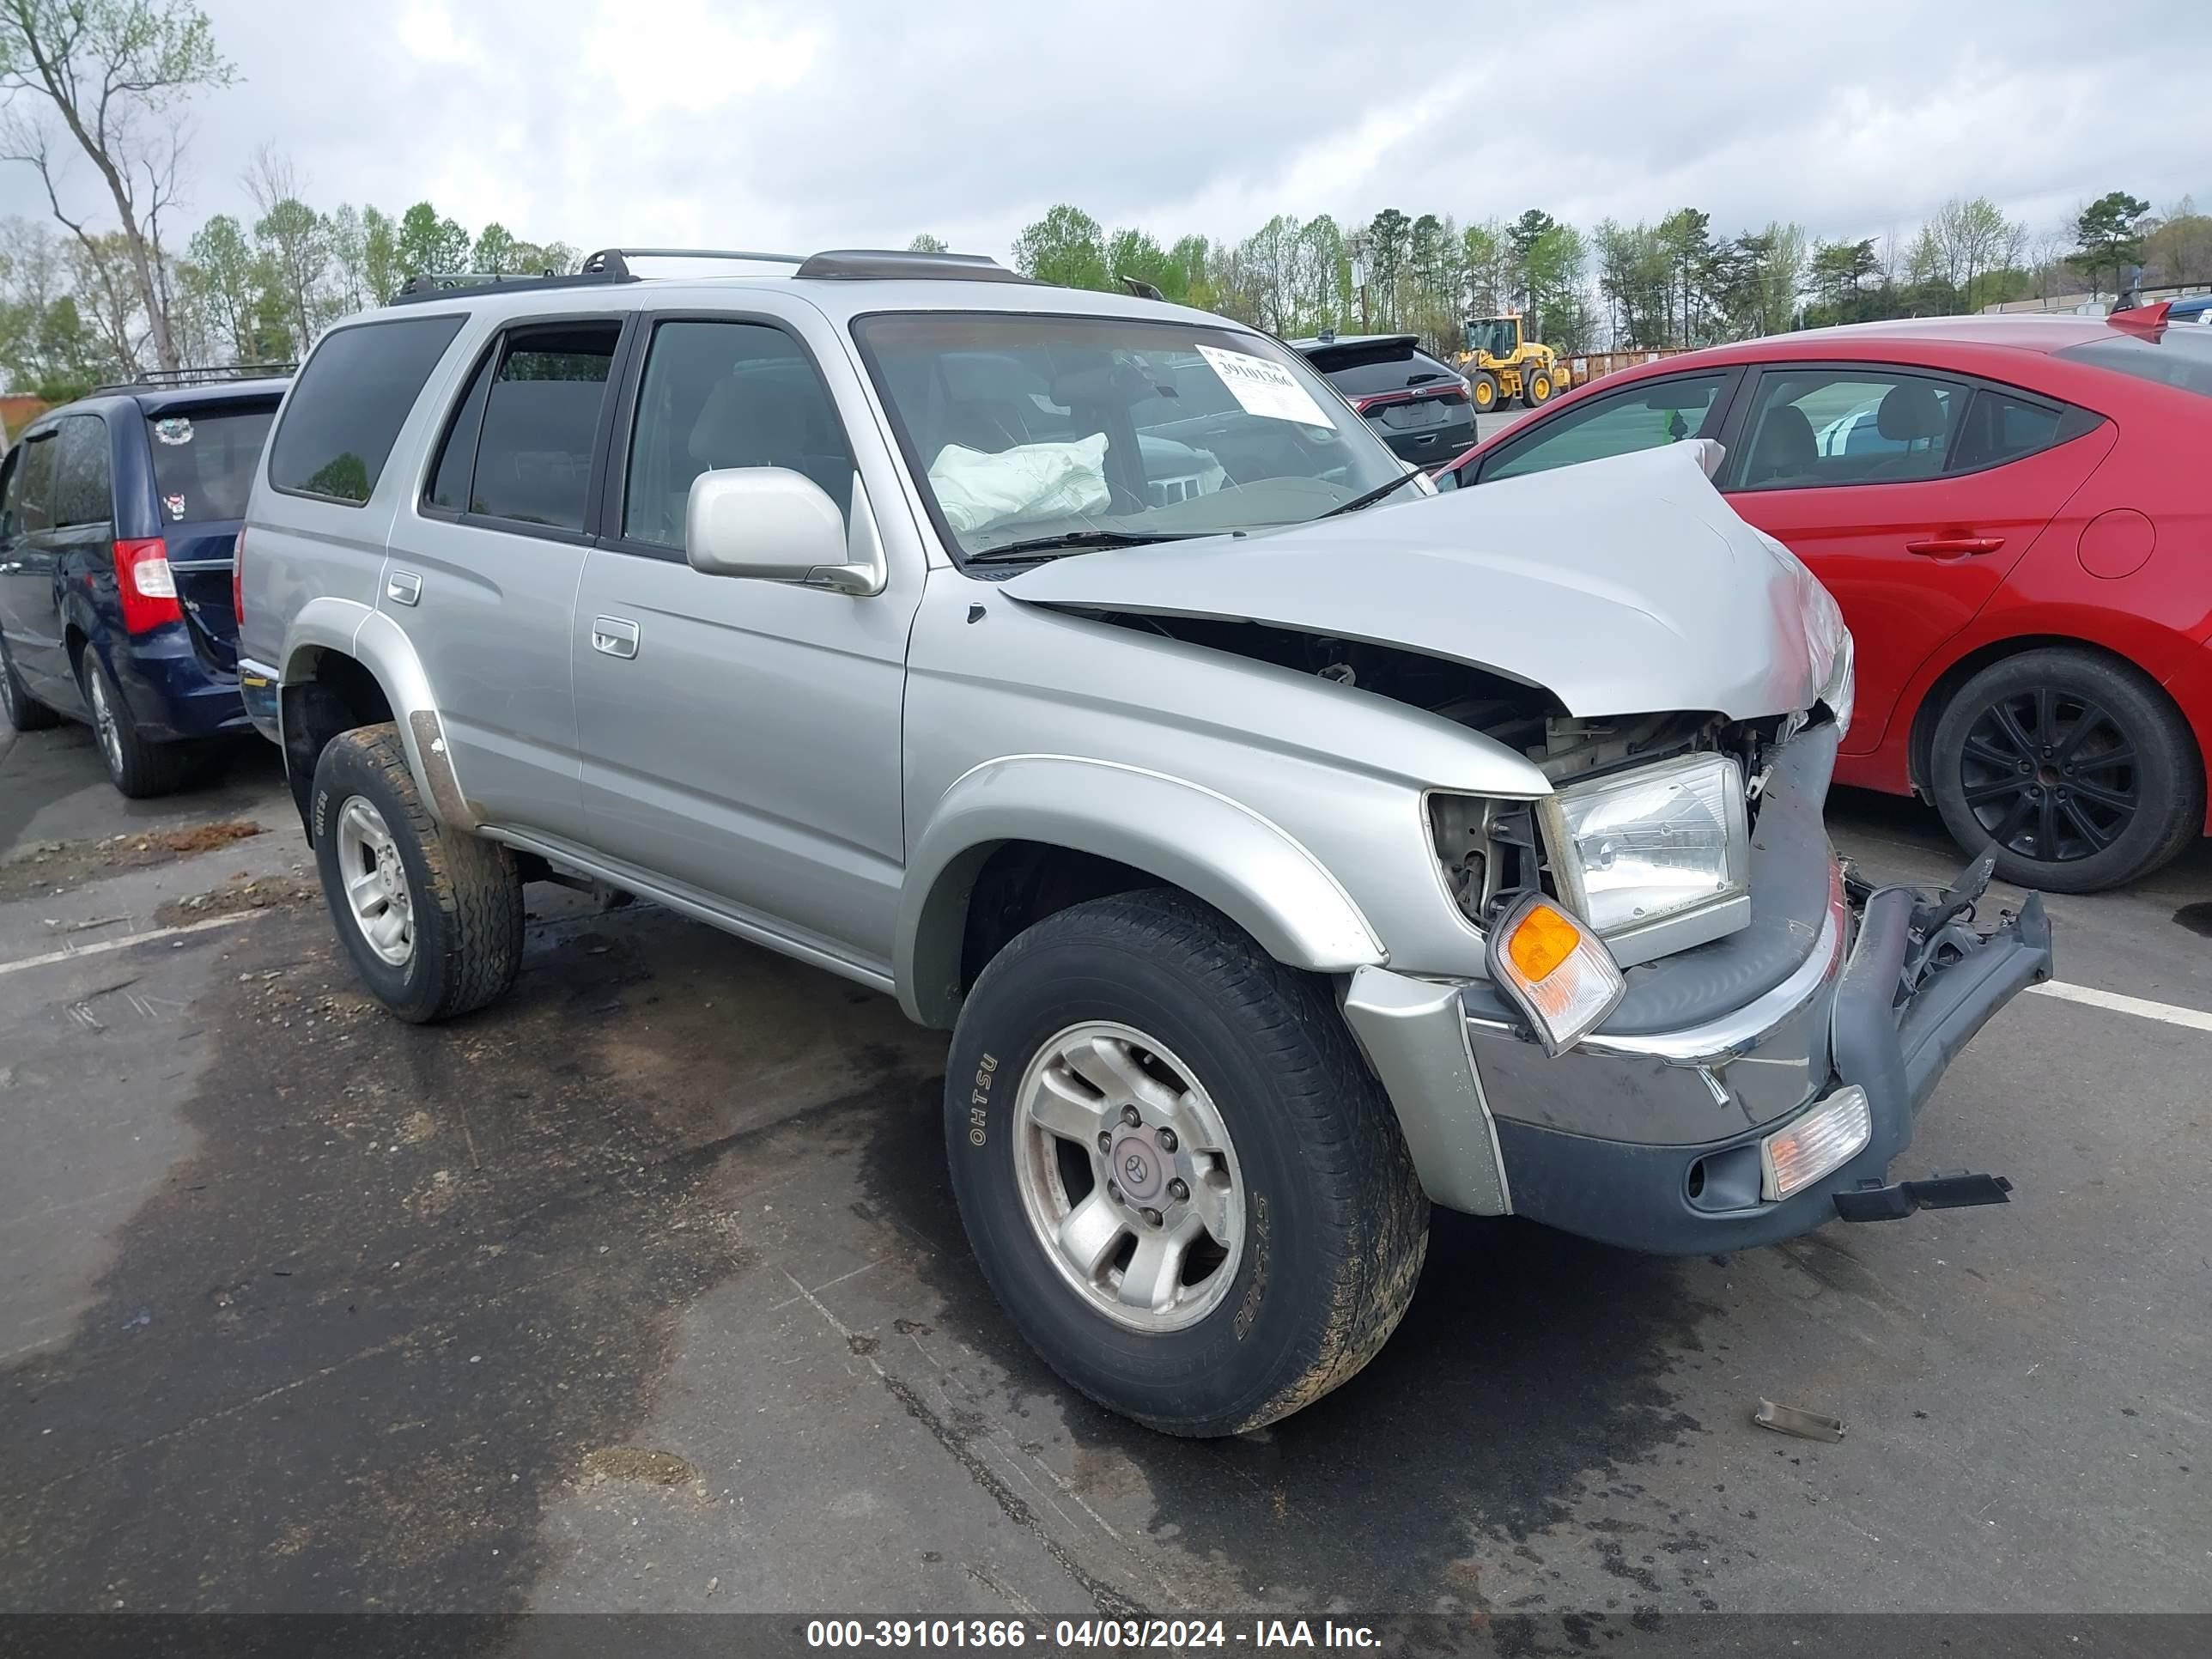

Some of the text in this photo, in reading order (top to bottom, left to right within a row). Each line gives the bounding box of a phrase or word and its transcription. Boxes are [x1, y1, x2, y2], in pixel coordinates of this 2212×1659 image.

[1218, 362, 1293, 387] 39101366
[315, 789, 329, 836] OHTSU
[969, 1052, 998, 1146] OHTSU
